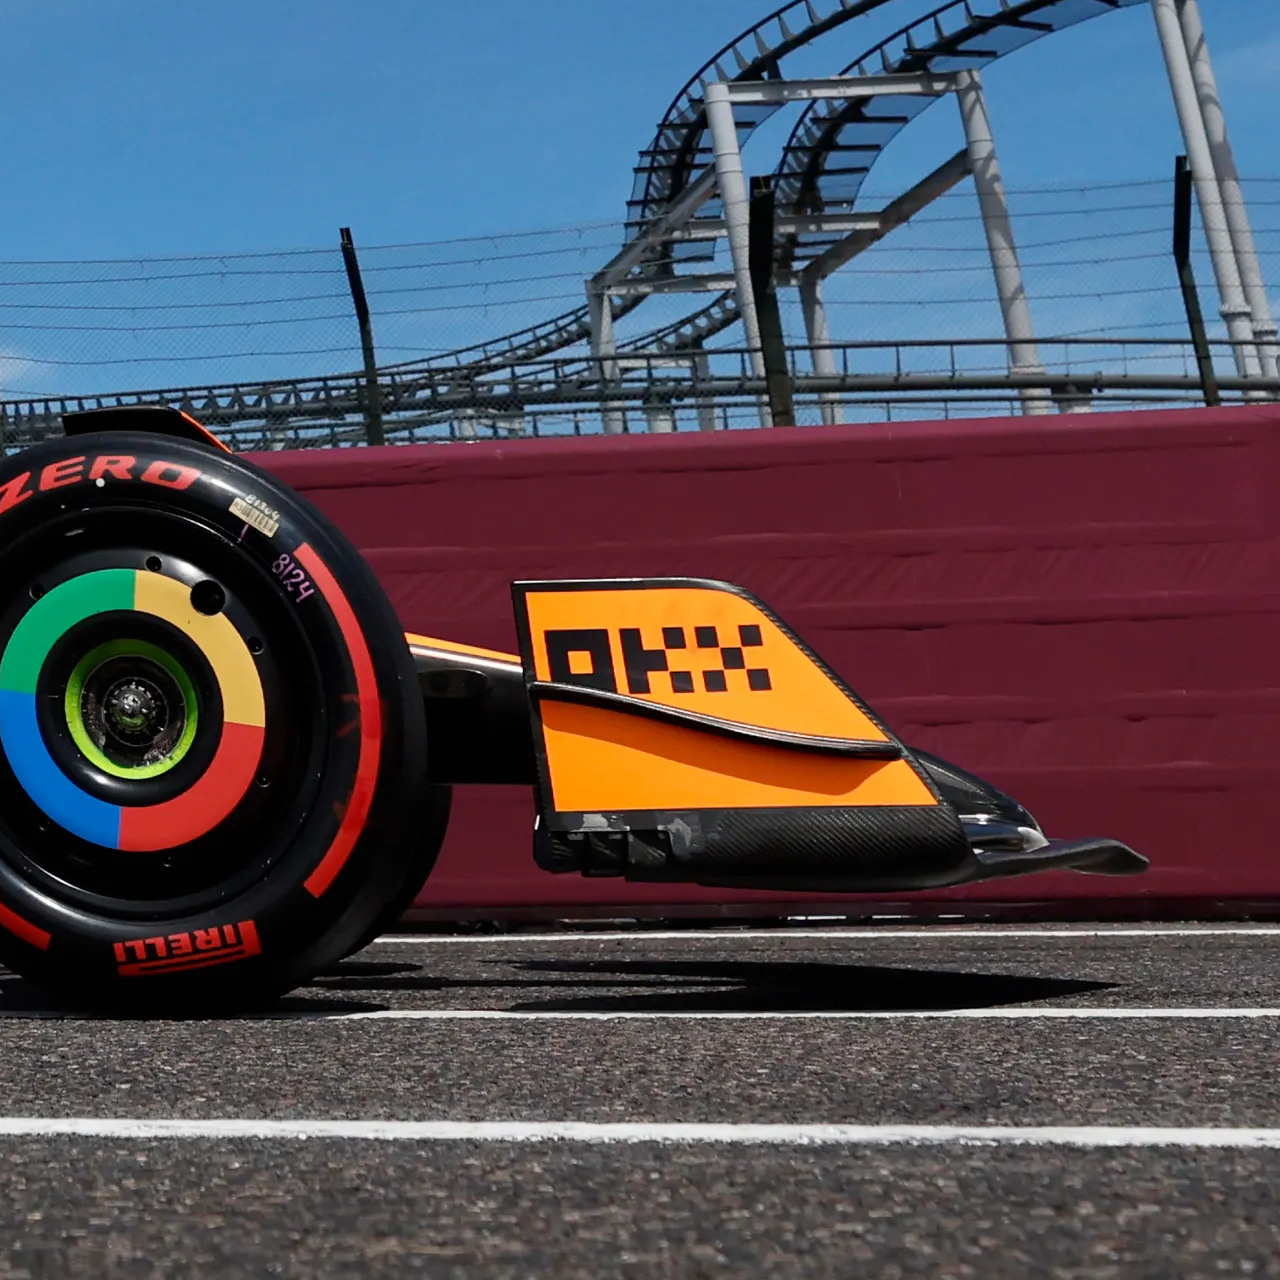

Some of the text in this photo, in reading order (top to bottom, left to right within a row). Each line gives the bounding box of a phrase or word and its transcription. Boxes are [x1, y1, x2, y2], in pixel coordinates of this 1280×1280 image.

[272, 553, 315, 604] 8124
[543, 624, 773, 695] OKX
[112, 919, 262, 977] PIRELLI
